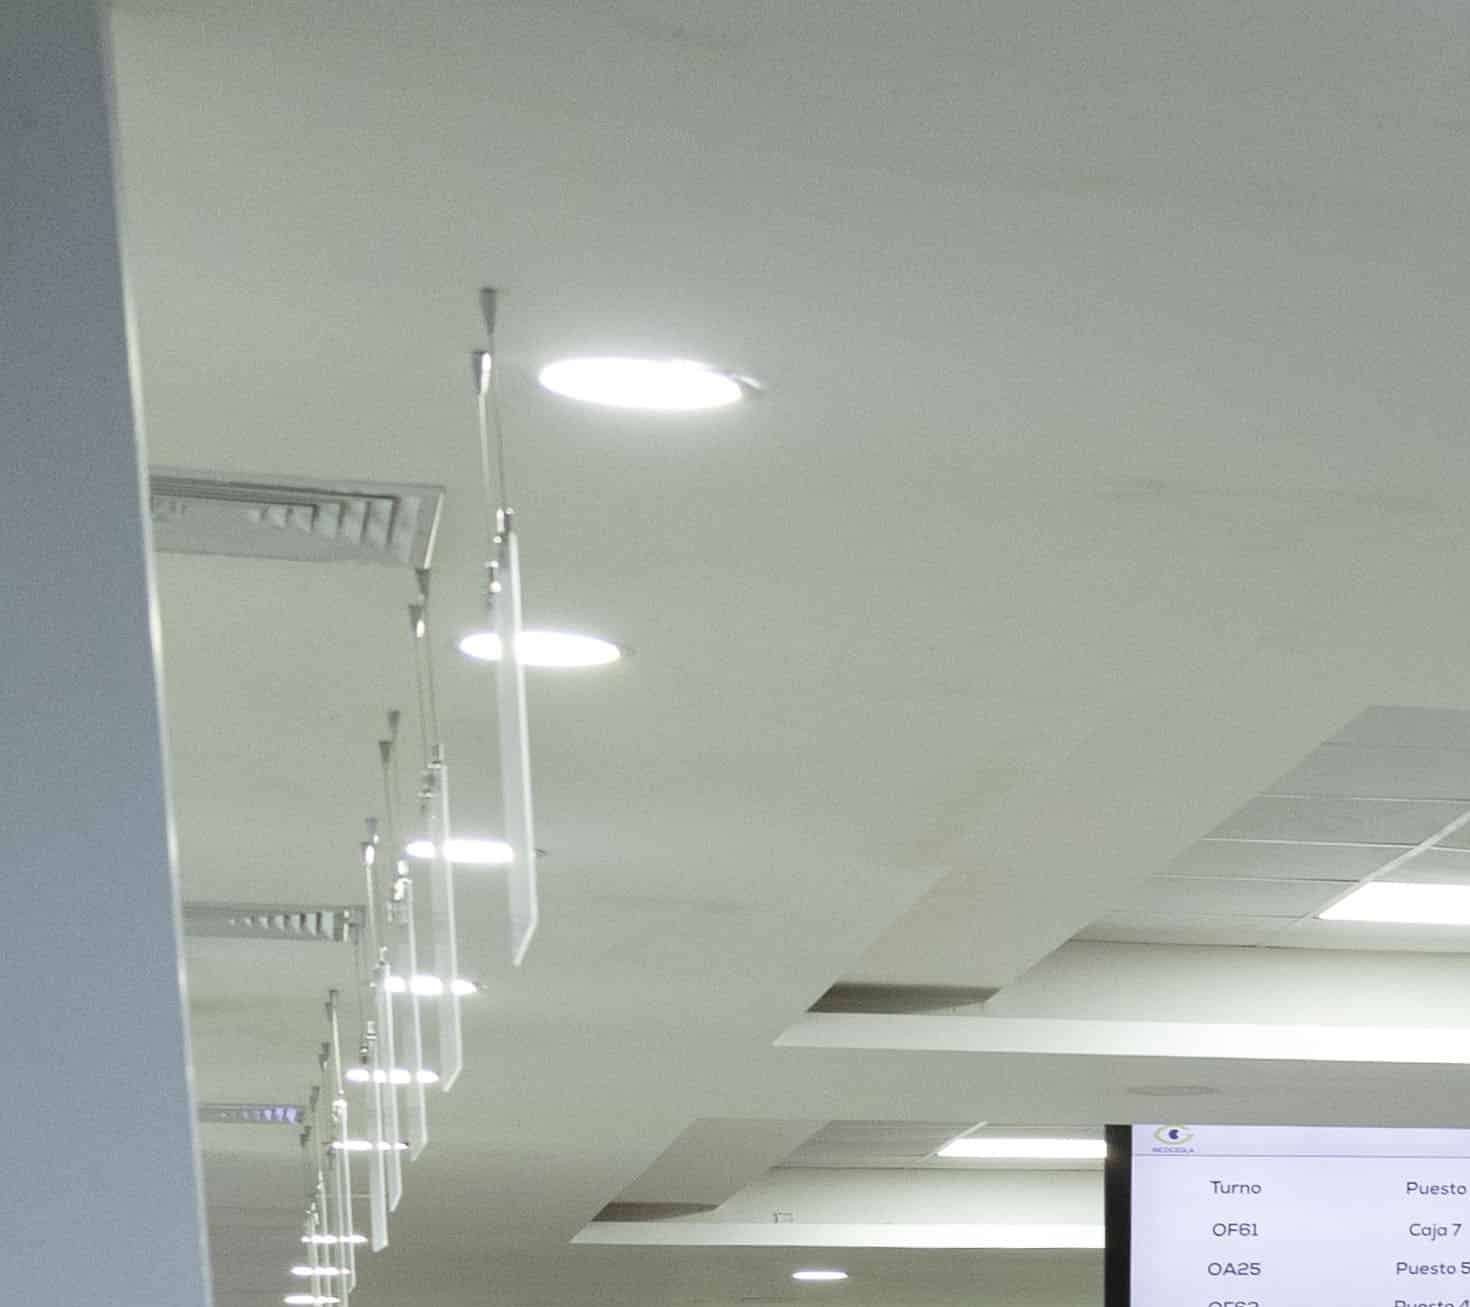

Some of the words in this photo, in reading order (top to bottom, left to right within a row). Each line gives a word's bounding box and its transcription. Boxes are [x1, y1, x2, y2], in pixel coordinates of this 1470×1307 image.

[1209, 1180, 1262, 1195] Turno
[1405, 1181, 1467, 1196] Puesto
[1212, 1222, 1259, 1237] OF61
[1408, 1223, 1448, 1242] Caja
[1451, 1223, 1462, 1237] 7
[1207, 1262, 1262, 1277] OA25
[1396, 1261, 1457, 1276] Puesto
